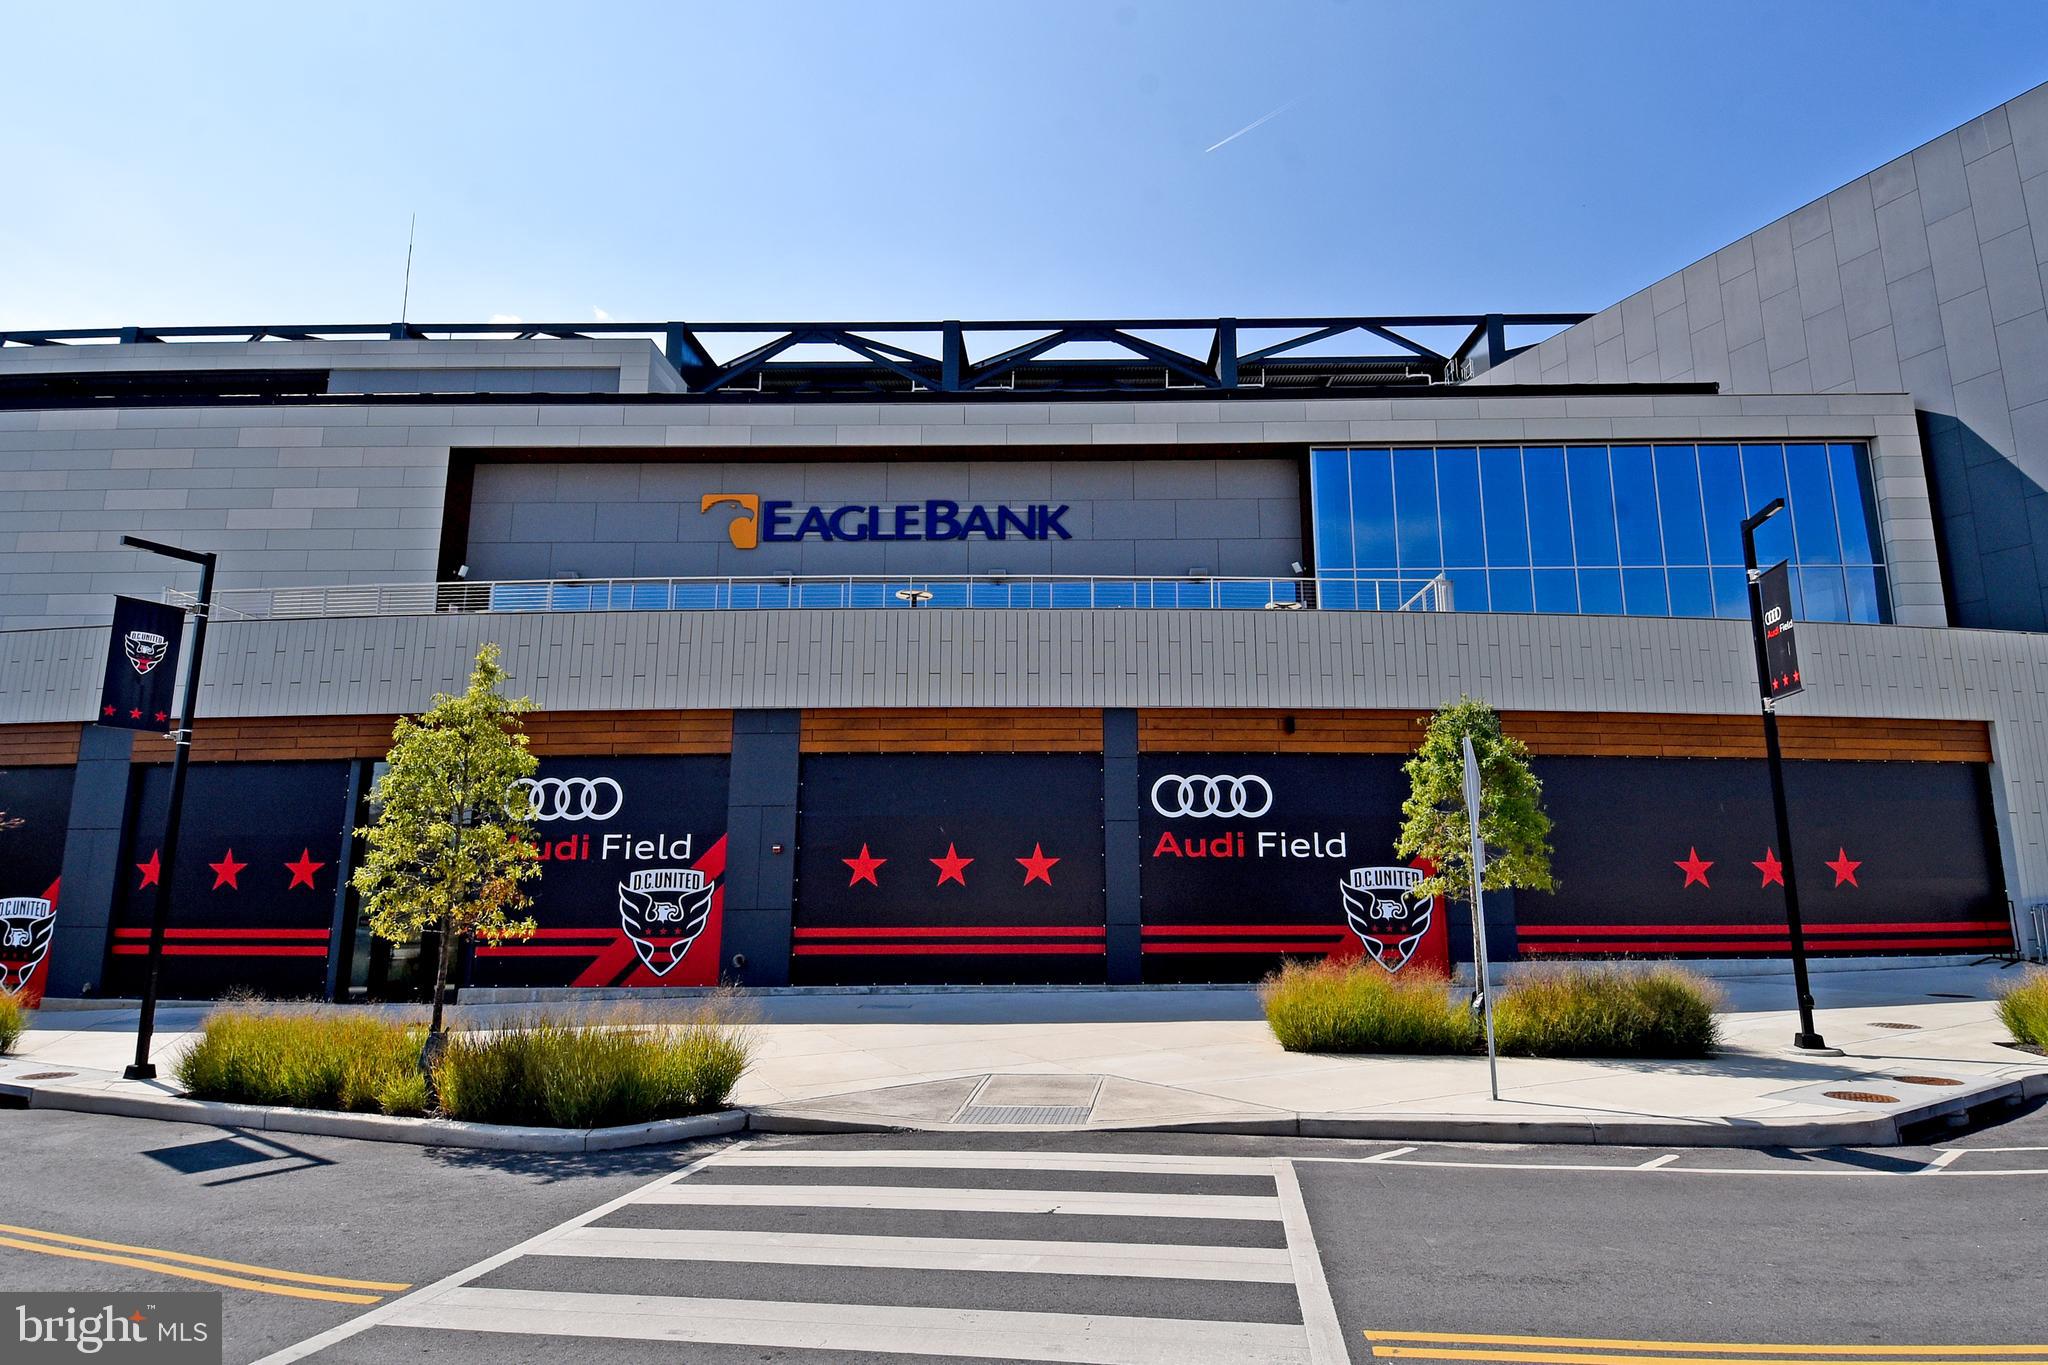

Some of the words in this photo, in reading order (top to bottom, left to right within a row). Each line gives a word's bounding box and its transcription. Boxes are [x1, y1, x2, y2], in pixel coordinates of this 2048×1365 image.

[762, 500, 1072, 541] EAGLEBANK
[1767, 627, 1780, 639] Audi
[1779, 619, 1793, 632] Field
[509, 834, 590, 861] udi
[602, 833, 692, 860] Field
[1153, 831, 1245, 858] Audi
[1258, 831, 1347, 858] Field
